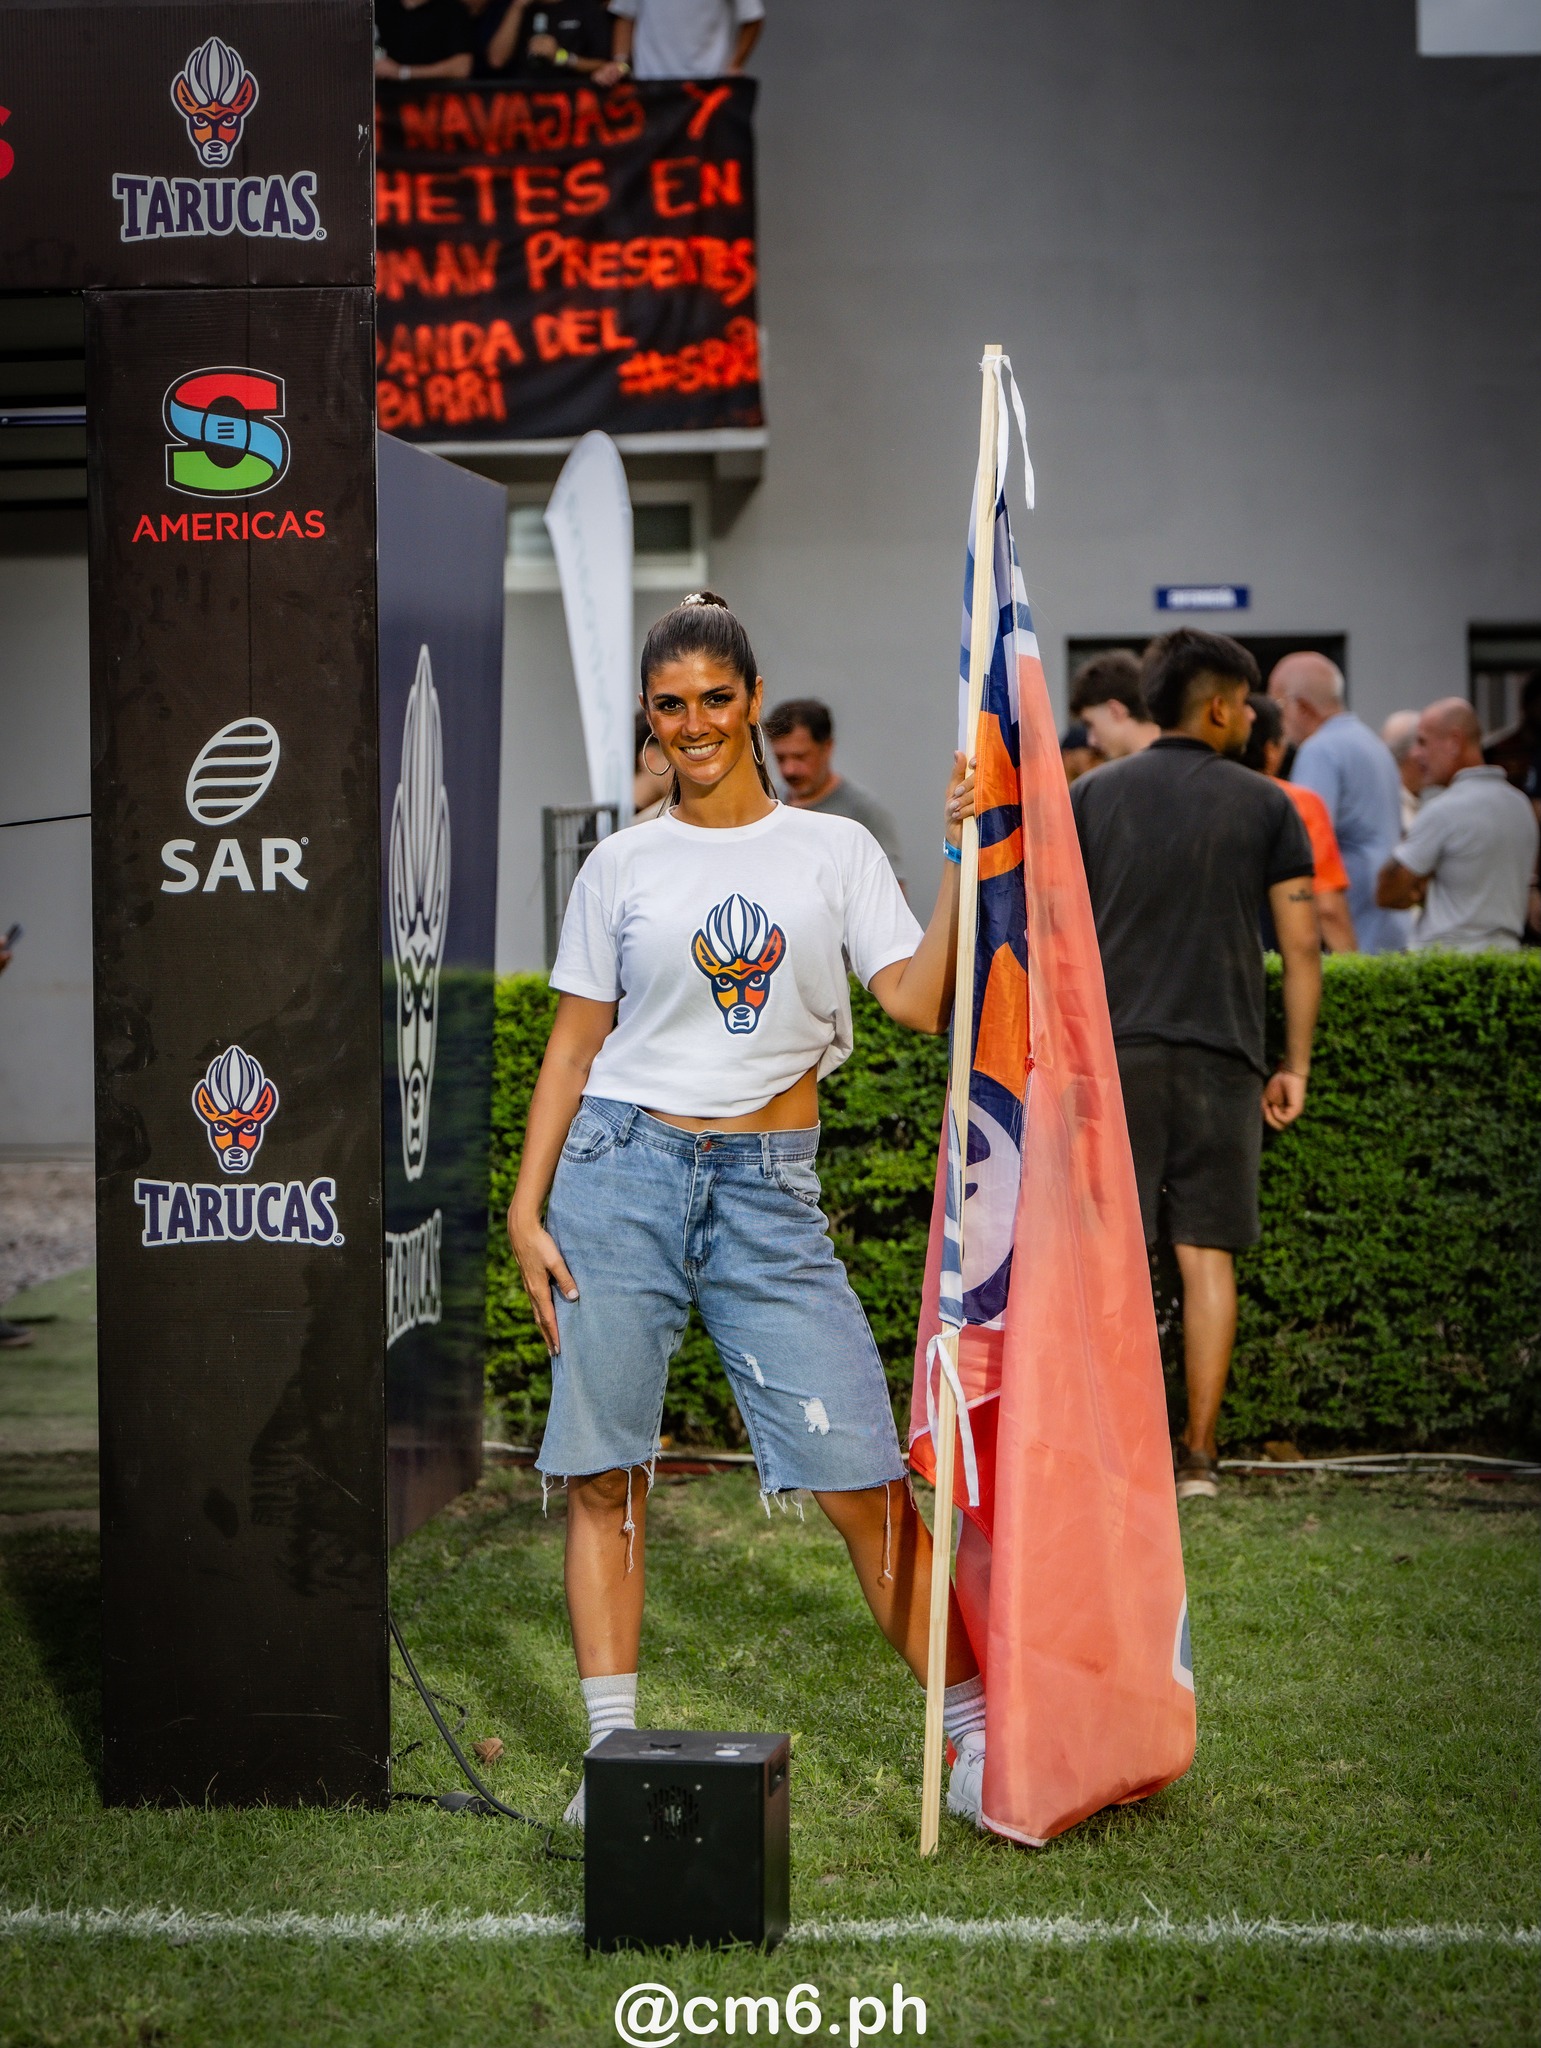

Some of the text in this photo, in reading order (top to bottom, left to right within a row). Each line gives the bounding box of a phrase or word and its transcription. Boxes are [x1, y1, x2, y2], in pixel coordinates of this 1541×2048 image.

[400, 86, 645, 155] NAVAJAS
[683, 82, 732, 140] Y
[650, 156, 743, 219] EN
[532, 307, 639, 362] DEL
[132, 510, 326, 543] AMERICAS
[160, 838, 309, 893] SAR
